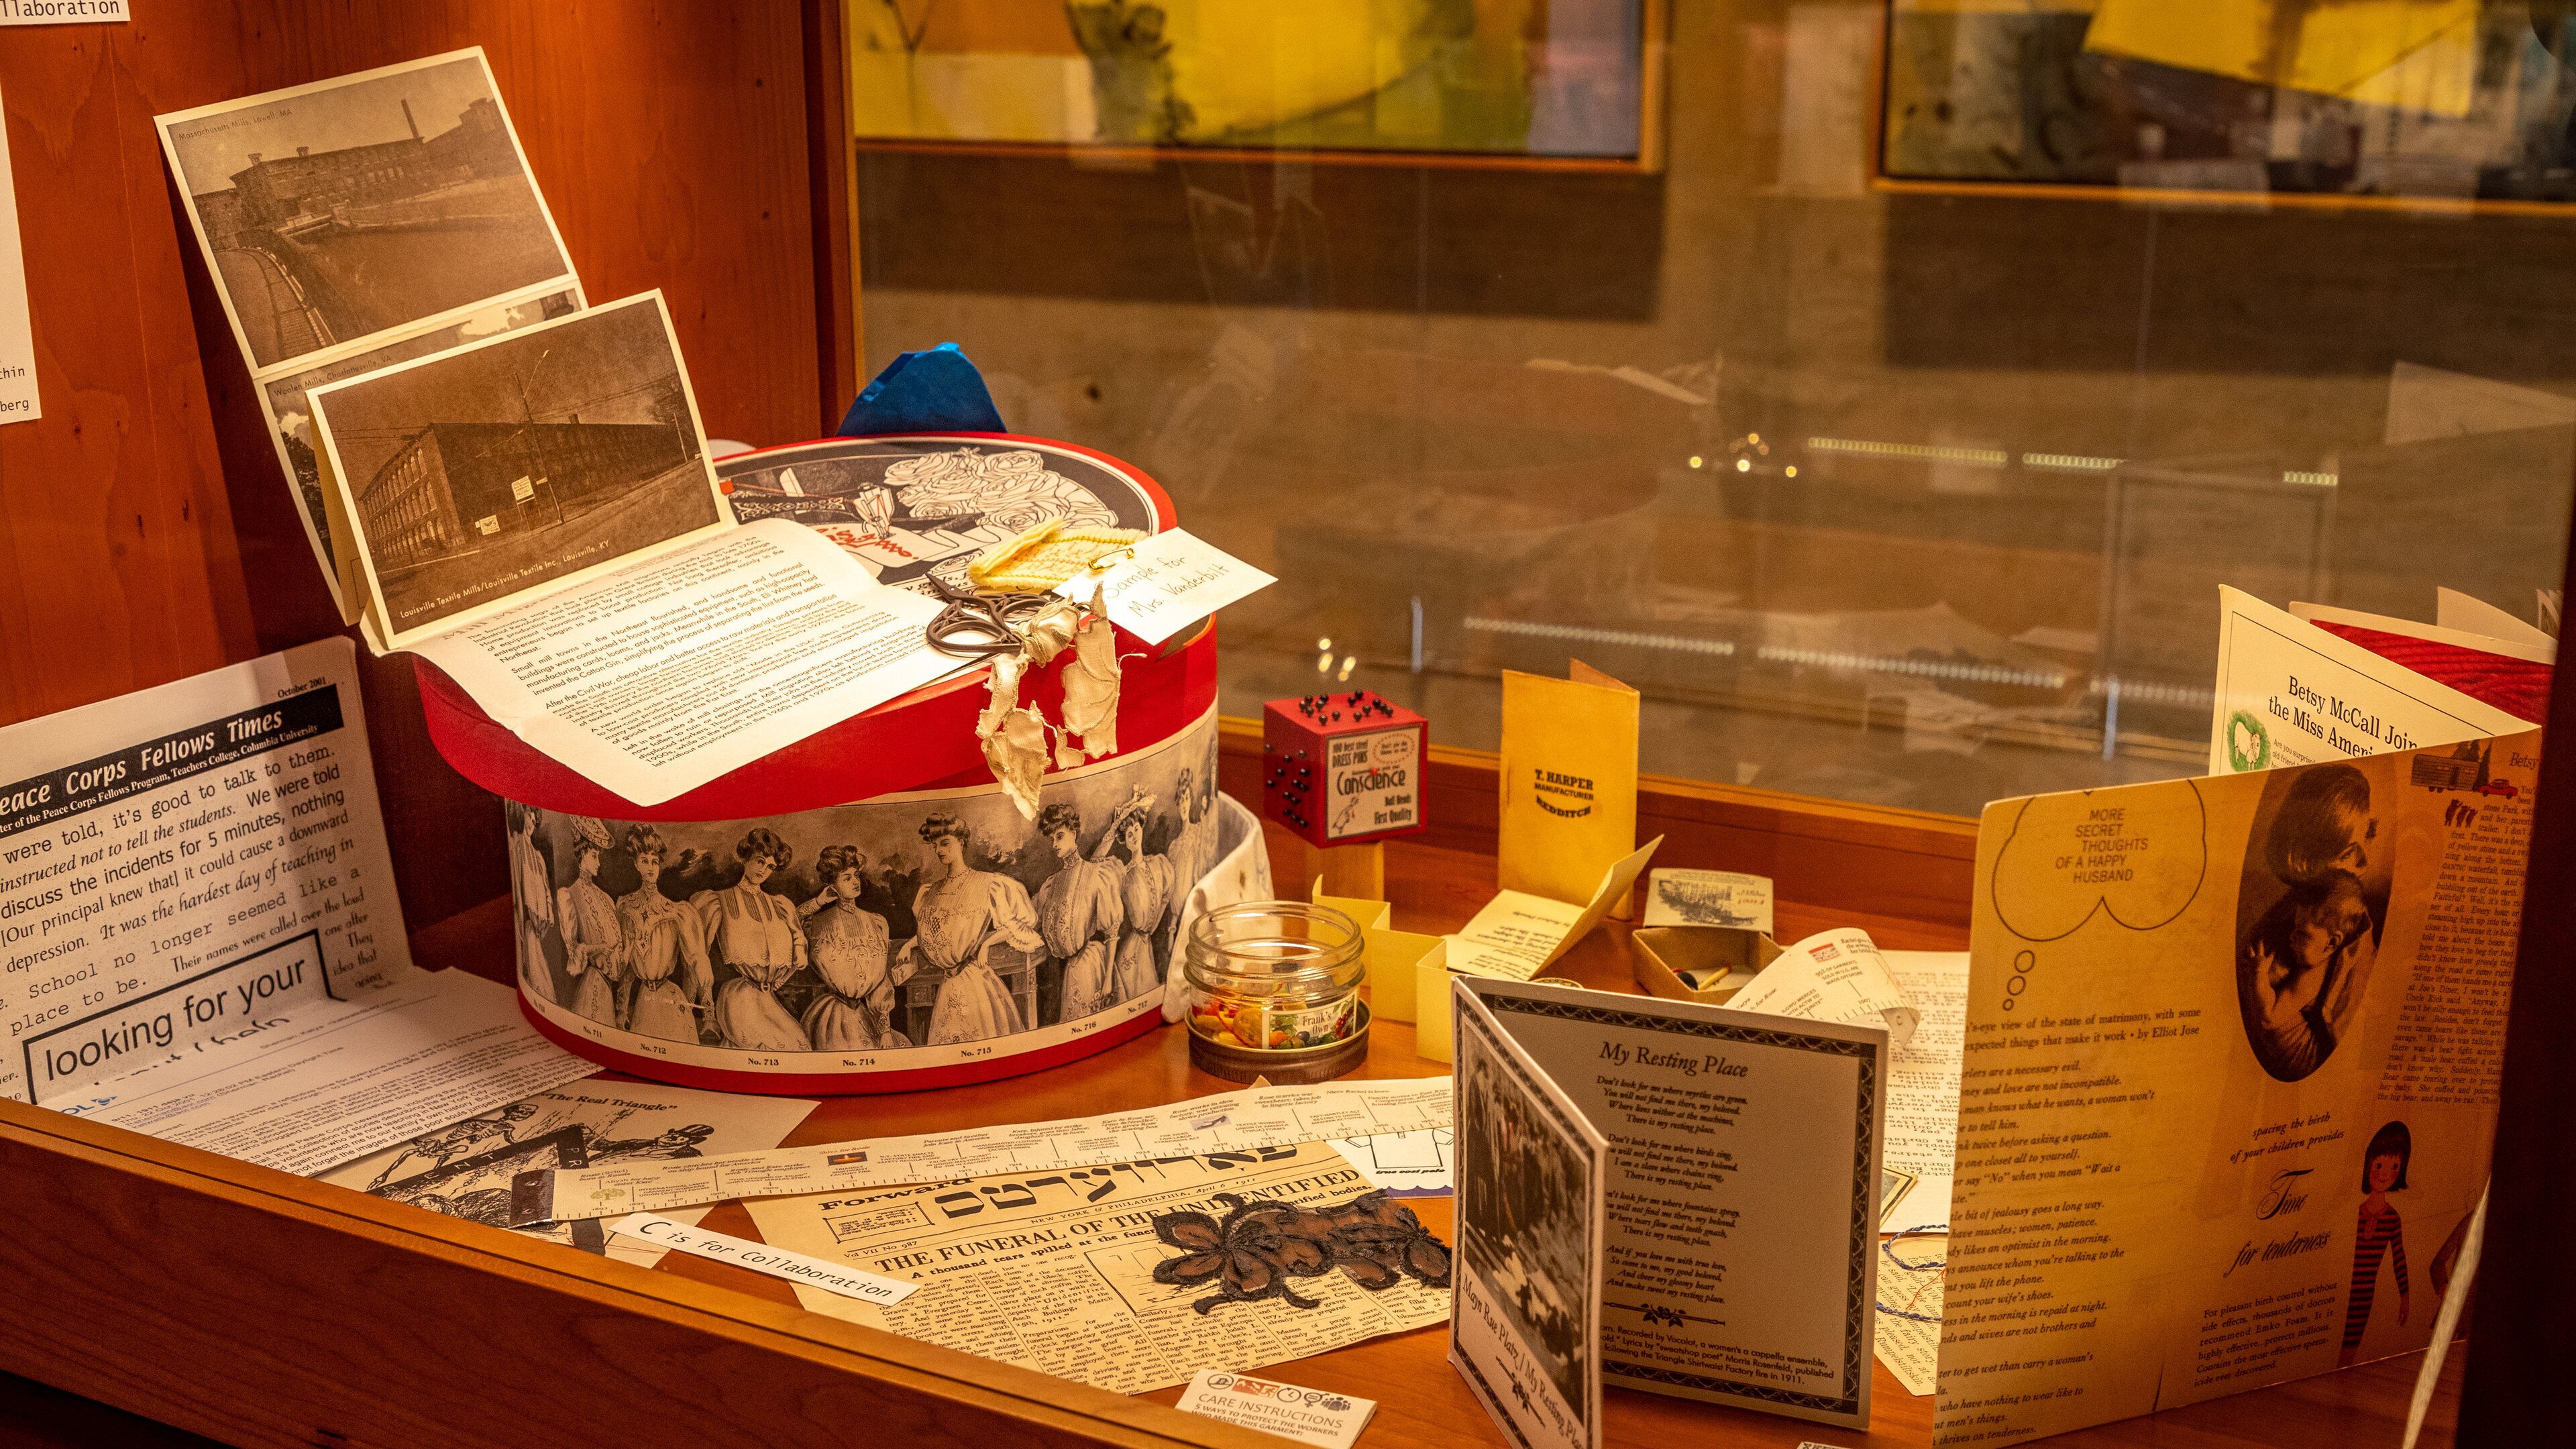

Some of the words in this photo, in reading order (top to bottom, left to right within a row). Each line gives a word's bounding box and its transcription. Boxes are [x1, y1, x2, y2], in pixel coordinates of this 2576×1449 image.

[179, 125, 229, 142] Massachusetts
[280, 109, 292, 117] MA
[274, 384, 301, 396] Woolen
[381, 355, 391, 363] VA
[400, 601, 435, 618] Louisville
[437, 592, 461, 604] Textile
[463, 573, 518, 596] Mills/Louisville
[519, 564, 543, 576] Textile
[563, 546, 598, 561] Louisville,
[599, 540, 608, 549] KY
[1104, 565, 1159, 598] Sample
[1157, 557, 1185, 568] for
[1128, 599, 1164, 617] Mrs.
[1160, 564, 1229, 595] Vanderbilt
[511, 662, 534, 674] Small
[539, 655, 552, 663] mill
[556, 647, 579, 657] towns
[610, 621, 648, 636] Northeast
[651, 605, 690, 621] flourished,
[278, 684, 307, 698] October
[309, 677, 326, 688] 2001
[2269, 696, 2289, 720] the
[2293, 707, 2323, 739] Miss
[2288, 676, 2326, 714] Betsy
[2329, 696, 2379, 739] McCall
[66, 761, 125, 794] Corps
[142, 733, 215, 771] Fellows
[227, 712, 282, 745] Times
[15, 818, 23, 828] of
[26, 814, 40, 825] the
[43, 806, 68, 819] Peace
[70, 797, 96, 810] Corps
[98, 786, 129, 801] Fellows
[131, 774, 170, 790] Program,
[171, 761, 207, 775] Teachers
[209, 751, 239, 765] College,
[241, 738, 279, 754] Columbia
[280, 727, 317, 743] University
[1337, 770, 1405, 796] Conscience
[1534, 783, 1593, 800] MANUFACTURER
[1535, 769, 1544, 780] T.
[1547, 771, 1593, 790] HARPER
[3, 840, 52, 863] were
[61, 821, 103, 845] told,
[113, 810, 142, 828] it's
[152, 790, 191, 819] good
[199, 785, 215, 799] to
[224, 769, 257, 790] talk
[265, 763, 281, 776] to
[289, 747, 334, 768] them.
[2089, 808, 2125, 821] MORE
[2076, 823, 2123, 838] SECRET
[2082, 838, 2147, 853] THOUGHTS
[2056, 856, 2073, 869] OF
[2075, 856, 2084, 867] A
[2088, 855, 2127, 867] HAPPY
[2074, 869, 2133, 883] HUSBAND
[46, 1013, 172, 1079] looking
[183, 991, 227, 1027] for
[237, 960, 304, 1013] your
[1312, 1025, 1329, 1034] Own
[1964, 1038, 2006, 1055] expected
[2010, 1037, 2039, 1049] things
[2043, 1035, 2061, 1045] that
[2065, 1033, 2090, 1044] make
[2094, 1033, 2100, 1042] it
[2104, 1030, 2126, 1041] work
[2137, 1028, 2149, 1041] by
[2152, 1027, 2177, 1038] Elliot
[2180, 1025, 2199, 1036] Jose
[748, 1057, 760, 1065] No.
[1599, 1041, 1629, 1065] My
[1635, 1046, 1698, 1075] Resting
[1702, 1055, 1748, 1077] Place
[576, 1096, 609, 1107] Real
[2253, 1124, 2287, 1140] spacing
[2290, 1118, 2304, 1129] the
[2308, 1112, 2330, 1126] birth
[2231, 1149, 2243, 1164] of
[2243, 1148, 2265, 1163] your
[2267, 1139, 2304, 1154] children
[2306, 1130, 2345, 1149] provides
[818, 1178, 974, 1211] Forward
[1030, 1216, 1055, 1225] NEW
[1060, 1210, 1088, 1219] YORK
[1108, 1193, 1191, 1210] PHILADELPHIA,
[1197, 1183, 1217, 1193] April
[1236, 1177, 1256, 1185] 1911
[2255, 1169, 2314, 1220] Time
[874, 1252, 933, 1272] THE
[936, 1230, 1067, 1260] FUNERAL
[1070, 1220, 1102, 1234] OF
[1110, 1210, 1159, 1228] THE
[2223, 1241, 2259, 1278] for
[2261, 1231, 2331, 1260] tenderness
[640, 1222, 672, 1235] C
[667, 1232, 690, 1242] is
[698, 1241, 735, 1252] for
[741, 1252, 892, 1297] Collaboration
[930, 1259, 987, 1275] thousand
[994, 1254, 1024, 1263] tears
[1031, 1243, 1072, 1256] spilled
[1463, 1274, 1483, 1313] Mayn
[1483, 1305, 1497, 1334] Rue
[1499, 1323, 1518, 1370] Platz
[1525, 1360, 1538, 1393] My
[1538, 1380, 1565, 1436] Resting
[1199, 1394, 1236, 1408] CARE
[1239, 1401, 1343, 1428] INSTRUCTIONS
[1203, 1406, 1226, 1415] WAYS
[1241, 1413, 1279, 1425] PROTECT
[1298, 1424, 1338, 1436] WORKERS
